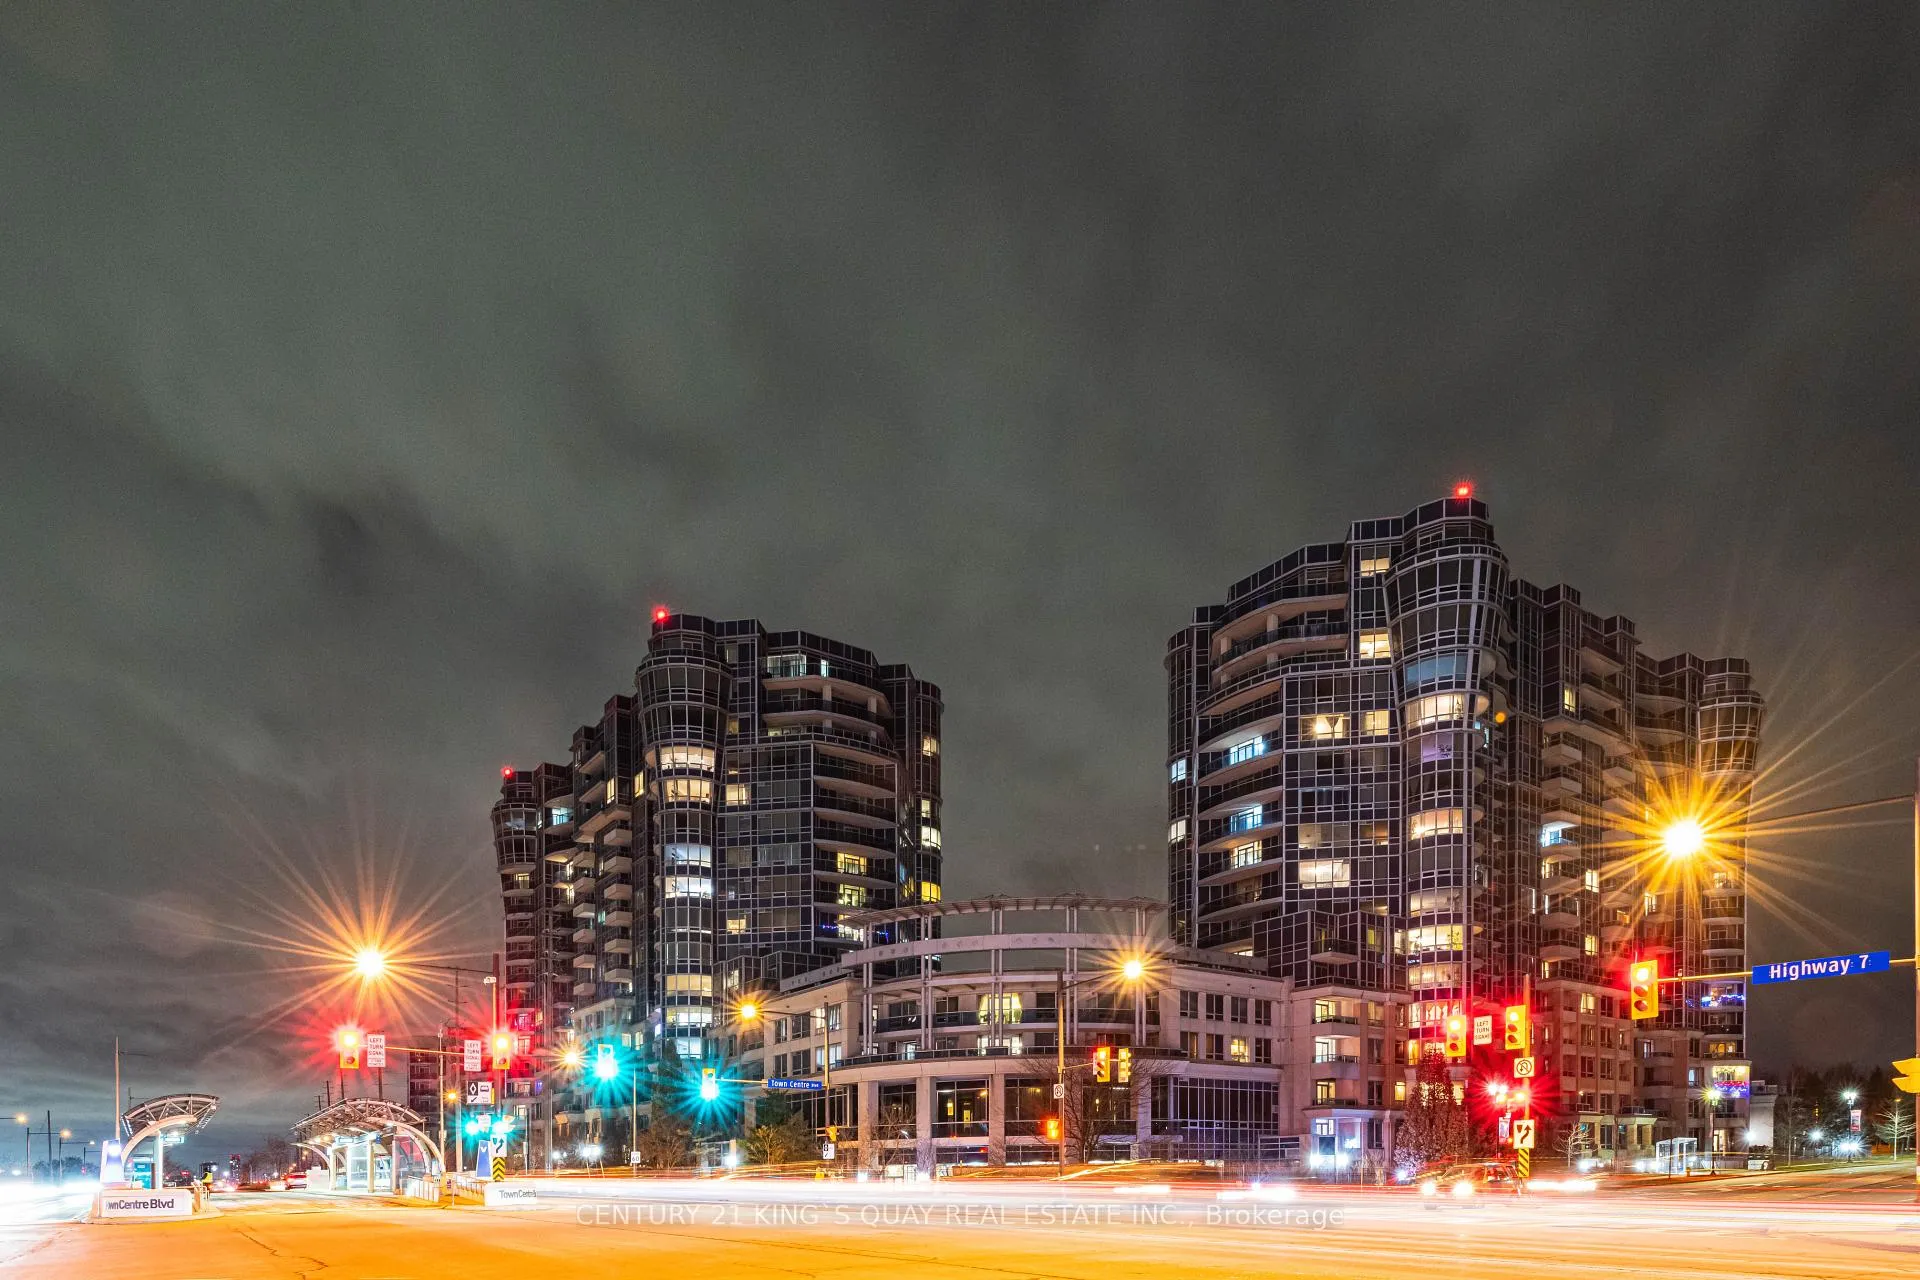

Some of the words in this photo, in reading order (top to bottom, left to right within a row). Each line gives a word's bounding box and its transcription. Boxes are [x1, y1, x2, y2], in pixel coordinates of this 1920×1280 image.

[1770, 959, 1850, 980] Highway
[1859, 954, 1869, 969] 7
[790, 1081, 810, 1089] Centre
[150, 1199, 175, 1209] Blvd
